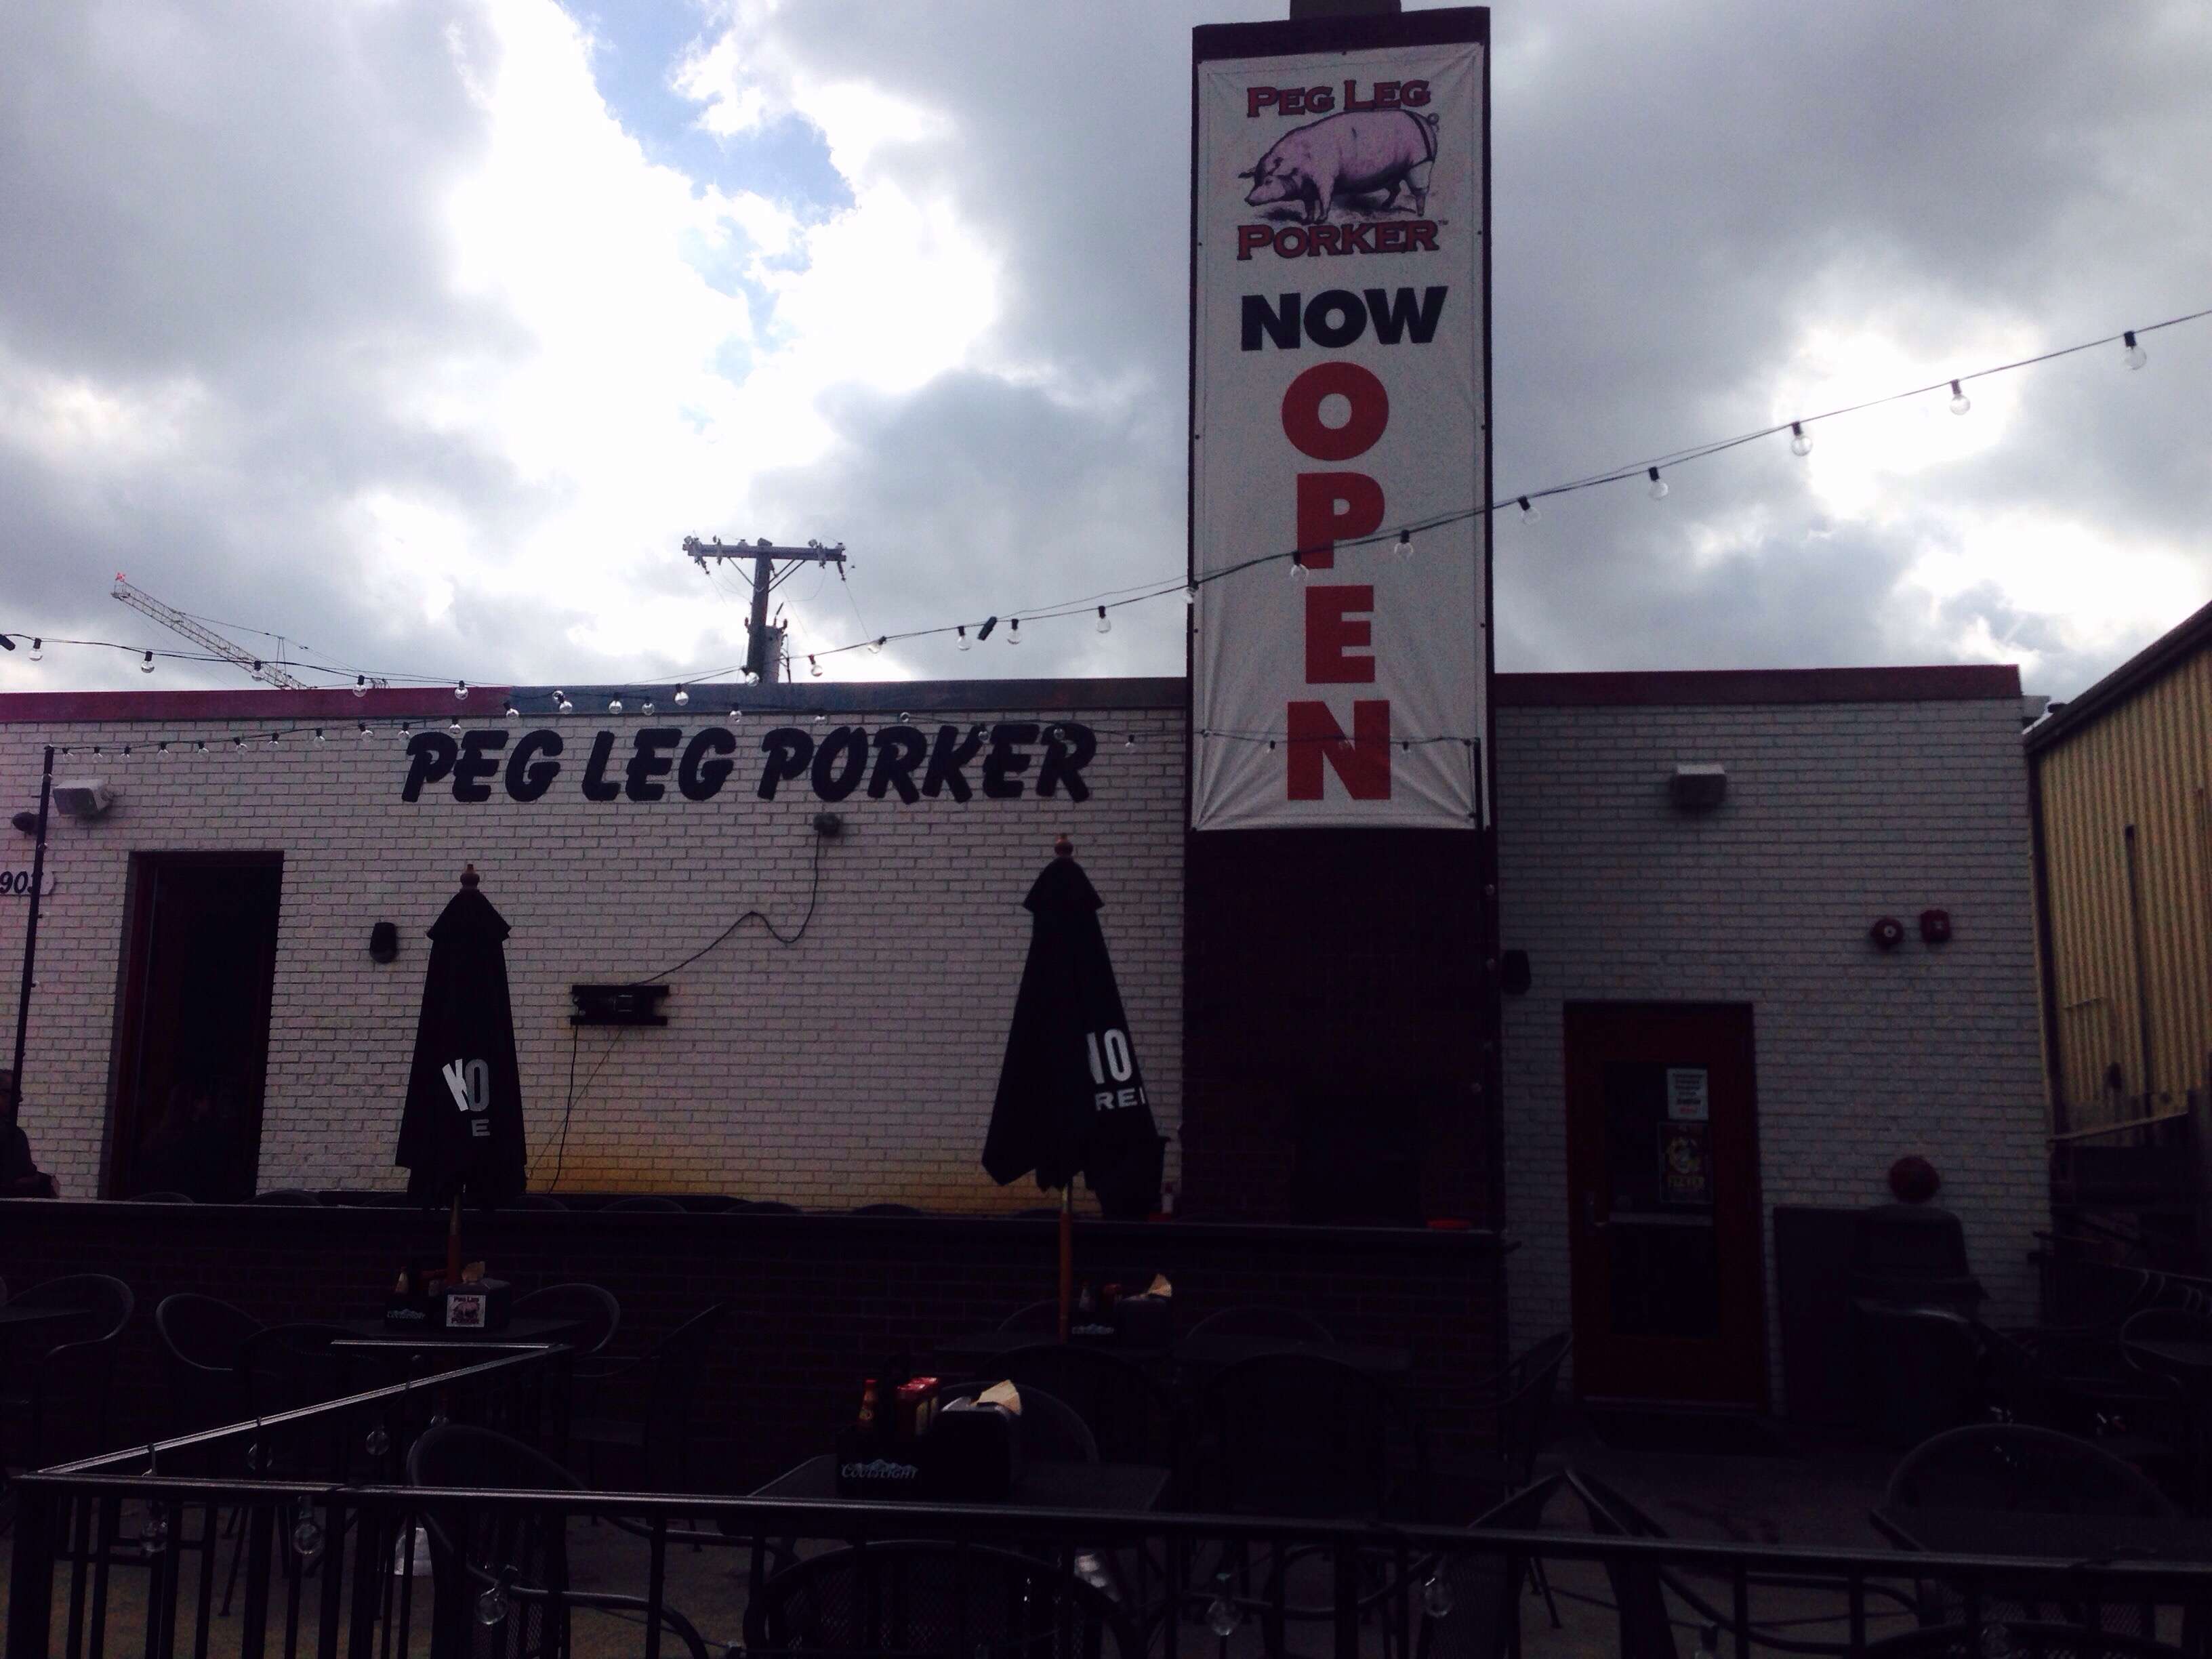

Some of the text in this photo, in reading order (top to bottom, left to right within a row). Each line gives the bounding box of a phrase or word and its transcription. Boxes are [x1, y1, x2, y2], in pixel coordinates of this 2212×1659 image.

[1247, 79, 1432, 118] PEG LEG
[1237, 220, 1439, 260] PORKER
[1242, 285, 1448, 351] NOW
[1281, 361, 1391, 800] OPEN
[401, 722, 1097, 804] PEG LEG PORKER
